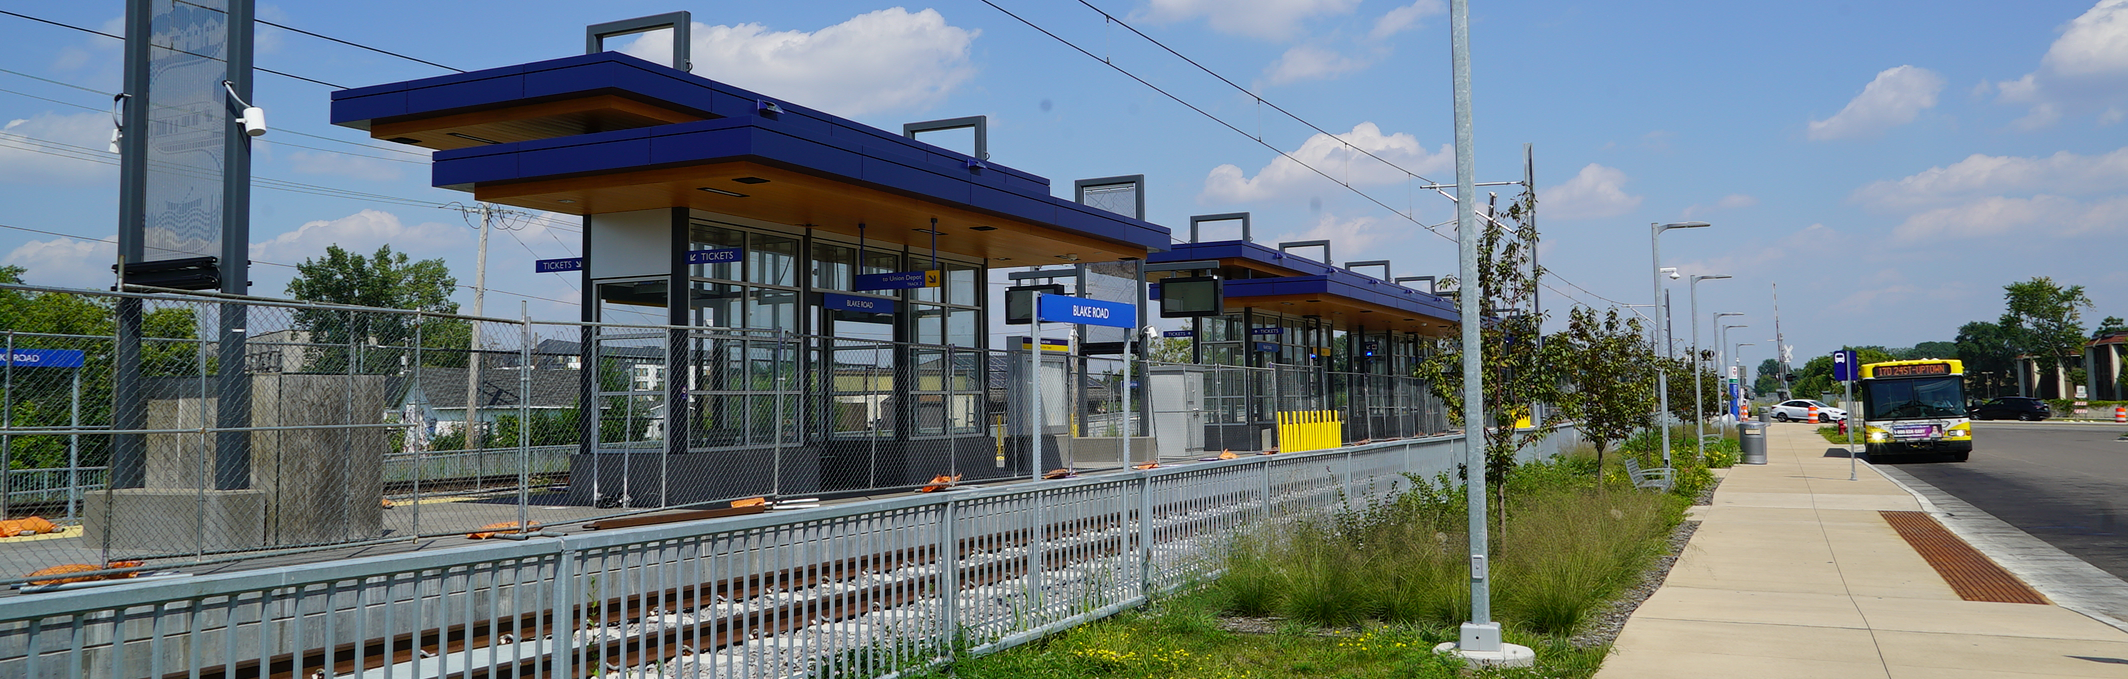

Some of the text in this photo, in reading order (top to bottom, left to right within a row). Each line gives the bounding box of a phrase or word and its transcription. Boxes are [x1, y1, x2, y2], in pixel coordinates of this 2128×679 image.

[701, 251, 734, 261] TICKETS
[543, 260, 572, 270] TICKETS
[906, 274, 921, 282] Depot
[1073, 305, 1109, 318] BLAKE ROAD
[13, 354, 39, 362] ROAD
